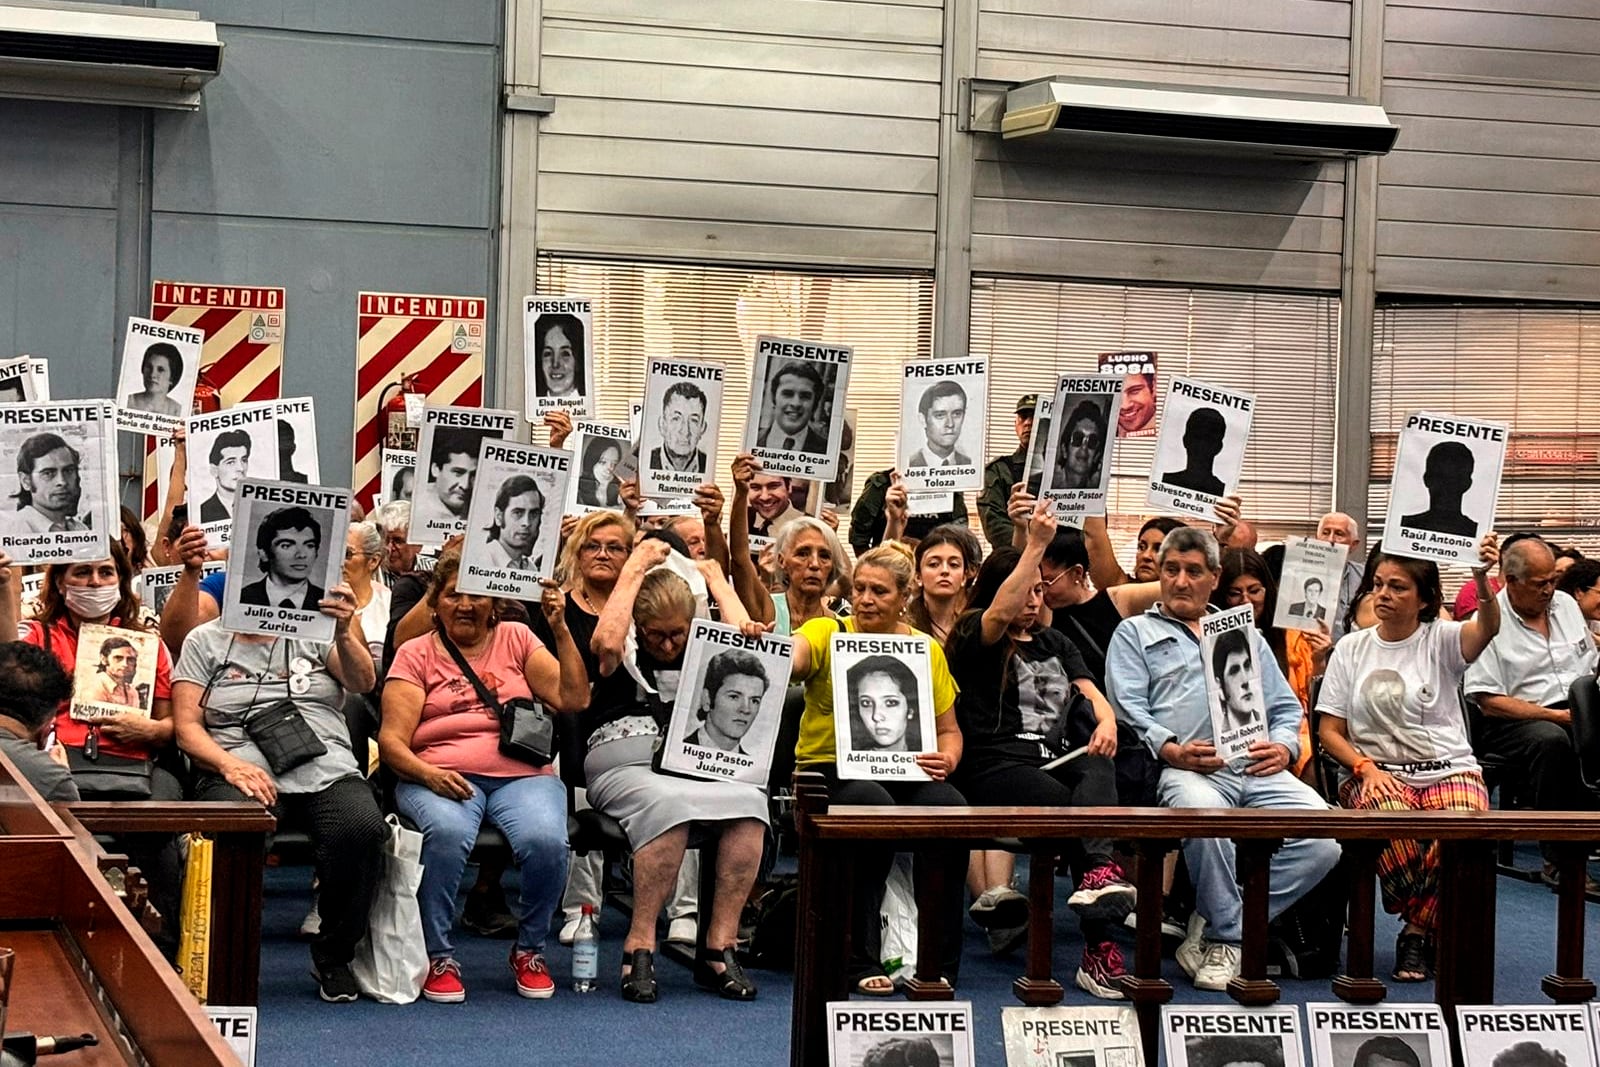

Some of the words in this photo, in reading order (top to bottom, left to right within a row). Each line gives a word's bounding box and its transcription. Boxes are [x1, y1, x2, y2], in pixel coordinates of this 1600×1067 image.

[161, 285, 278, 308] INCENDIO
[366, 296, 478, 318] INCENDIO
[527, 301, 591, 313] PRESENTE
[131, 323, 201, 344] PRESENTE
[759, 341, 849, 363] PRESENTE
[1107, 354, 1149, 363] LUCHO
[651, 362, 724, 381] PRESENTE
[904, 362, 985, 377] PRESENTE
[1099, 363, 1156, 375] SOSA
[1060, 379, 1123, 393] PRESENTE
[538, 398, 555, 407] Elsa
[557, 398, 584, 408] Raquel
[1172, 381, 1251, 411] PRESENTE
[117, 408, 153, 420] Segunda
[277, 402, 310, 414] ENTE
[116, 417, 138, 427] Soria
[140, 422, 150, 430] de
[190, 408, 273, 433] PRESENTE
[427, 411, 515, 429] PRESENTE
[577, 422, 631, 438] PRESEN
[1407, 416, 1504, 442] PRESENTE
[385, 454, 416, 465] PRESE
[484, 446, 569, 471] PRESENTE
[751, 448, 795, 461] Eduardo
[798, 454, 830, 465] Oscar
[763, 461, 802, 473] Bulacio
[804, 466, 815, 474] E.
[904, 468, 926, 478] José
[929, 467, 976, 477] Francisco
[924, 479, 956, 487] Toloza
[1151, 482, 1193, 499] Silvestre
[241, 484, 348, 509] PRESENTE
[1043, 491, 1077, 501] Segundo
[1078, 491, 1104, 499] Pastor
[1056, 502, 1086, 511] Rosales
[426, 520, 451, 530] Juan
[2, 535, 51, 547] Ricardo
[55, 533, 98, 544] Ramón
[1401, 528, 1427, 541] Raúl
[1429, 533, 1473, 548] Antonio
[28, 547, 73, 558] Jacobe
[1411, 543, 1458, 558] Serrano
[468, 565, 507, 579] Ricardo
[486, 580, 522, 593] Jacobe
[244, 607, 274, 618] Julio
[278, 609, 316, 622] Oscar
[258, 621, 298, 633] Zurita
[1203, 610, 1253, 637] PRESENTE
[695, 626, 792, 657] PRESENTE
[835, 640, 926, 654] PRESENTE
[1220, 730, 1239, 744] Daniel
[1239, 724, 1264, 737] Roberto
[682, 745, 713, 762] Hugo
[715, 752, 754, 768] Pastor
[847, 753, 889, 763] Adriana
[891, 753, 916, 764] Ceci
[695, 760, 736, 777] Juárez
[835, 1012, 967, 1032] PRESENTE
[1022, 1019, 1122, 1037] PRESENTE
[1170, 1013, 1295, 1034] PRESENTE
[1315, 1011, 1441, 1031] PRESENTE
[1464, 1013, 1585, 1032] PRESENTE
